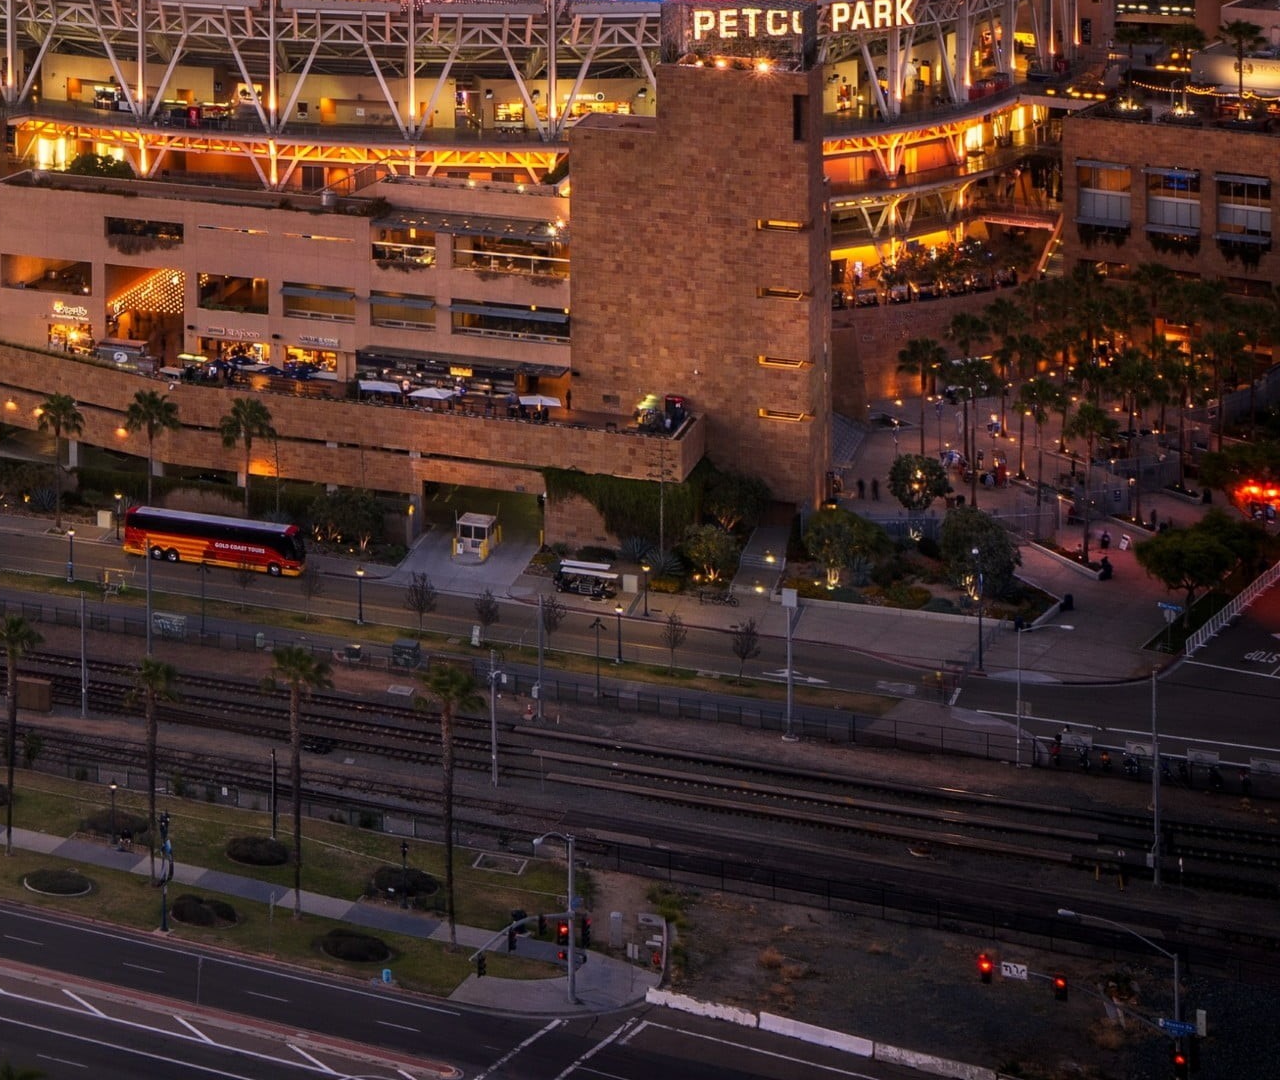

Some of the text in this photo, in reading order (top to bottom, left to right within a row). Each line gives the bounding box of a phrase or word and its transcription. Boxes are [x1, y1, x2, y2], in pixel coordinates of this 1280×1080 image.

[214, 541, 265, 554] GOLD COAST TOURS
